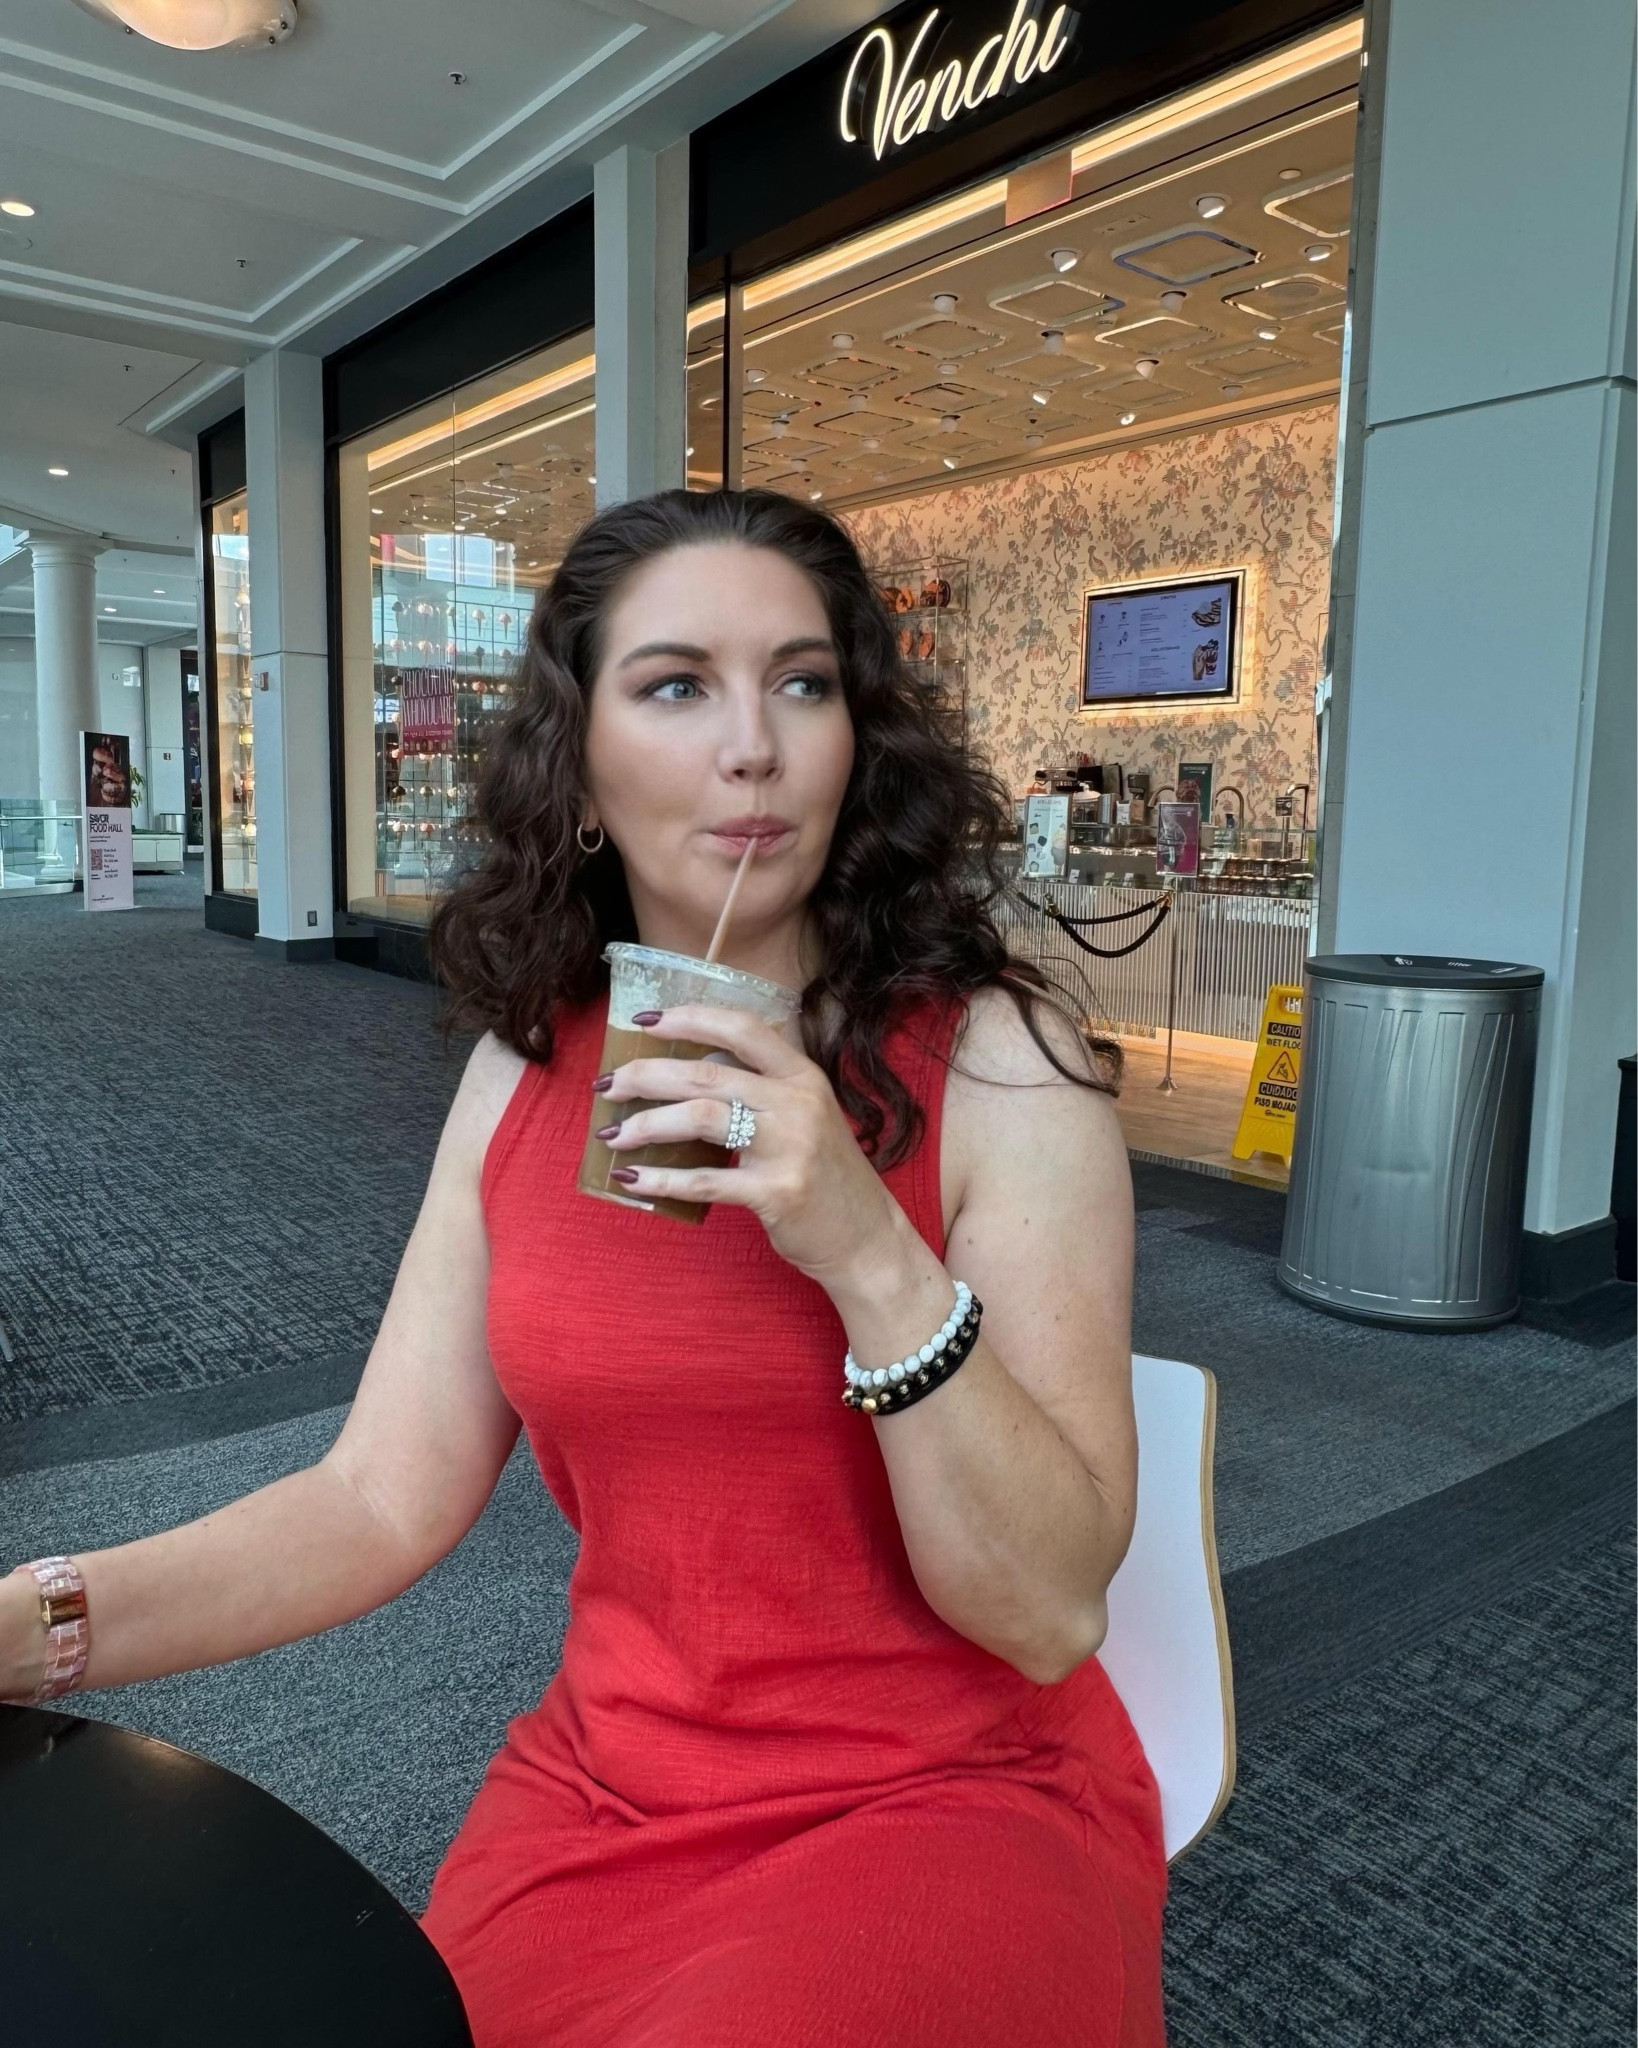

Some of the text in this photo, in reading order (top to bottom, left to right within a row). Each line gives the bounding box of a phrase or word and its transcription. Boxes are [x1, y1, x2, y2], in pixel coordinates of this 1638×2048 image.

[840, 0, 1069, 161] Venchi
[90, 823, 123, 832] FOOD HALL
[1271, 1023, 1301, 1038] CAUTIO
[1266, 1038, 1301, 1050] WET FLOO
[1260, 1083, 1298, 1099] CUIDADO
[1254, 1096, 1296, 1112] PISO MOJAD
